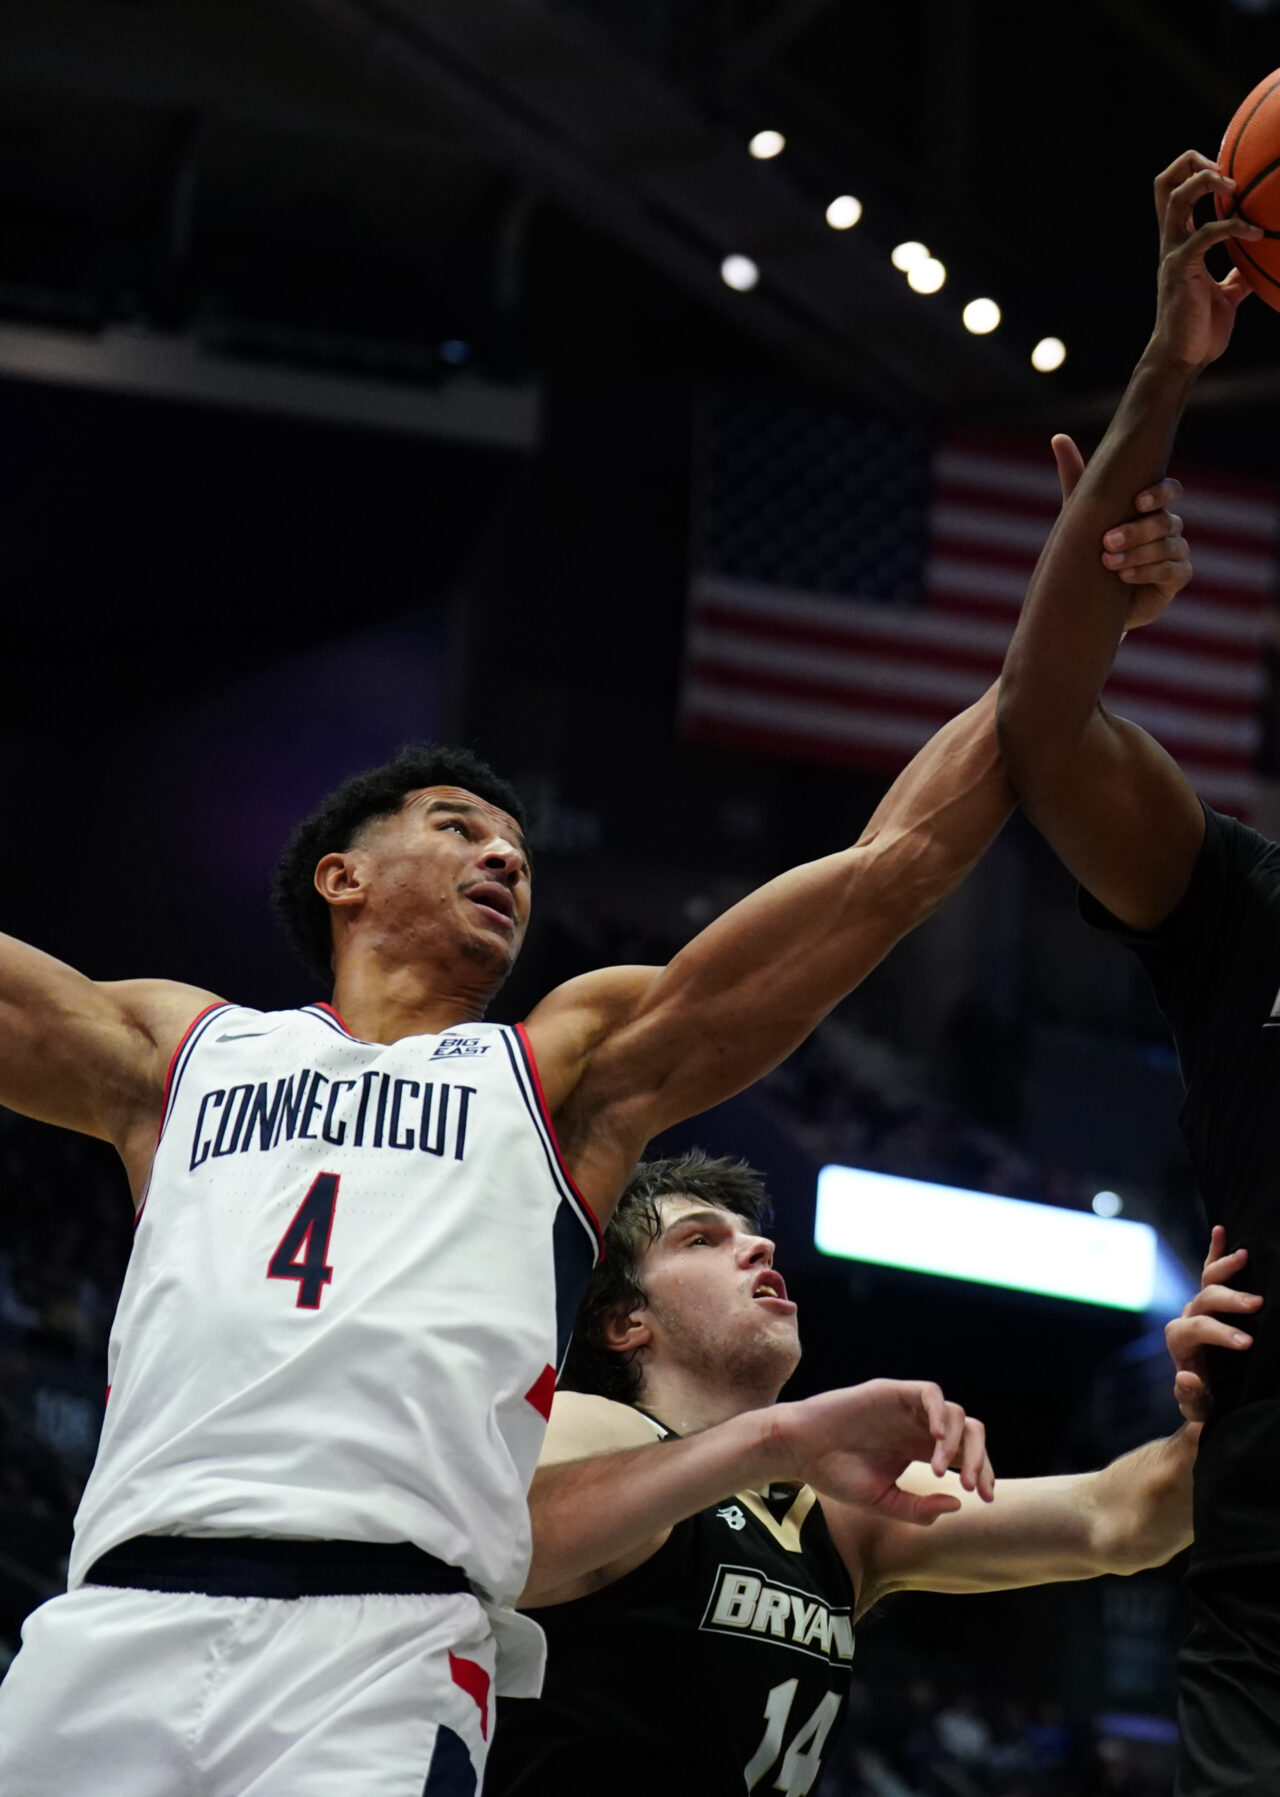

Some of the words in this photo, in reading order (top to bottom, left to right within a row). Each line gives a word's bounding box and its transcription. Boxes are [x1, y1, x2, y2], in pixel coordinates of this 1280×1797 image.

[433, 1046, 492, 1055] EAST
[439, 1038, 481, 1047] BIG
[189, 1069, 477, 1172] CONNECTICUT
[266, 1171, 341, 1309] 4
[743, 1678, 843, 1797] 14
